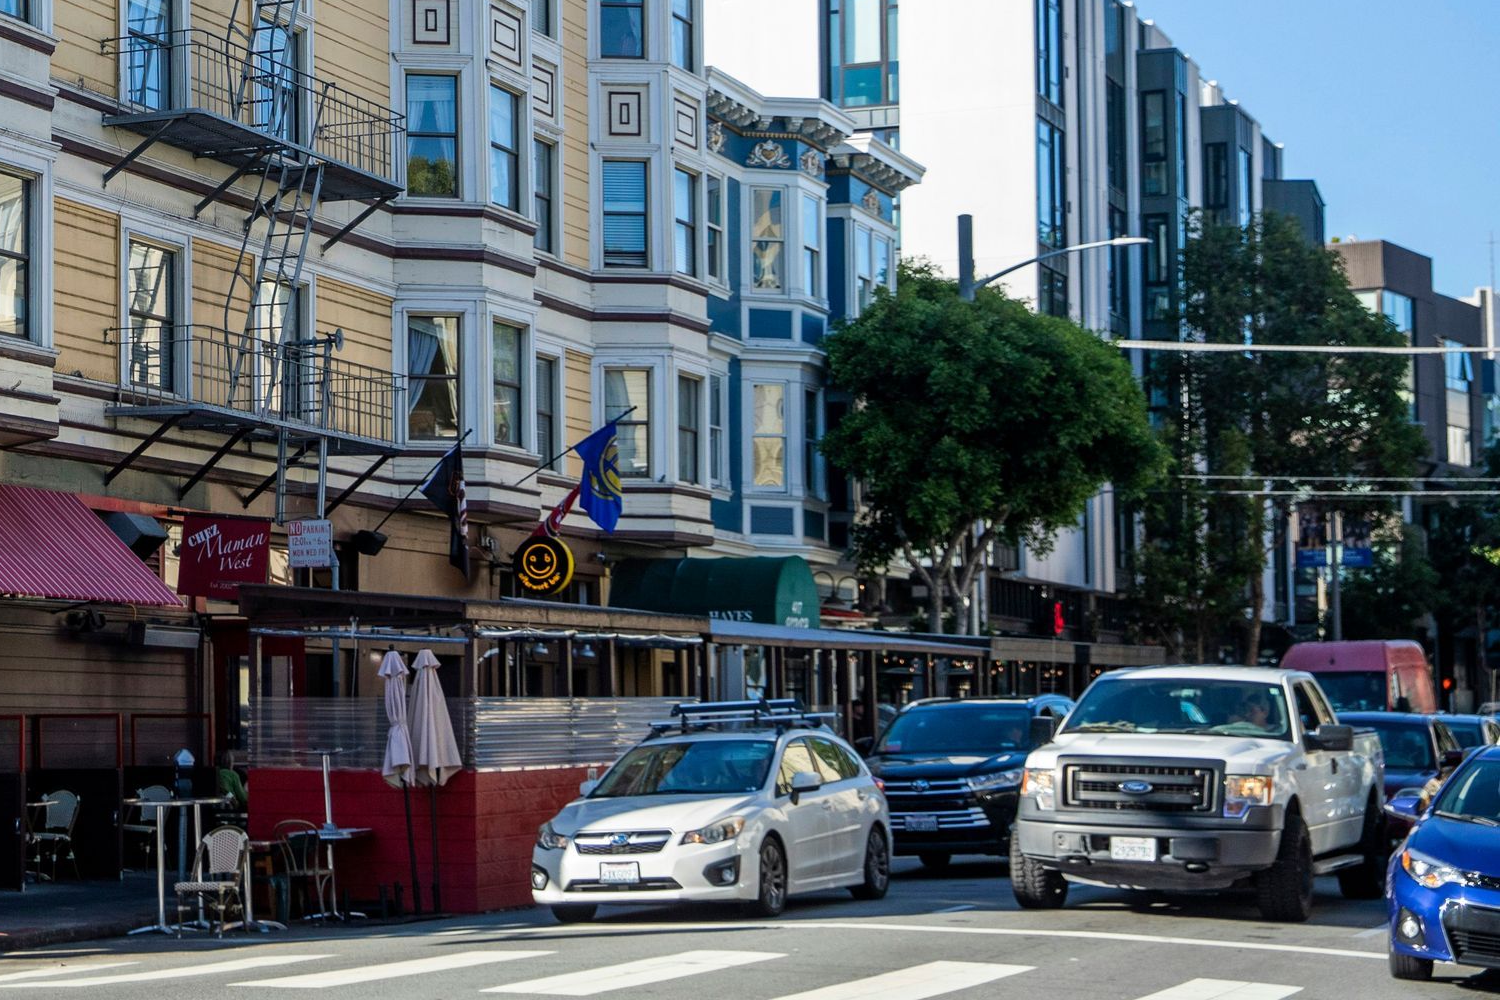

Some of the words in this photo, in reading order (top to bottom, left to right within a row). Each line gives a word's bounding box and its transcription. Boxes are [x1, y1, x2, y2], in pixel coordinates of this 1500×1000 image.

[188, 523, 220, 547] CHEZ
[290, 521, 302, 536] NO
[303, 525, 329, 534] PARKIN
[197, 533, 268, 563] Maman
[219, 552, 254, 571] West
